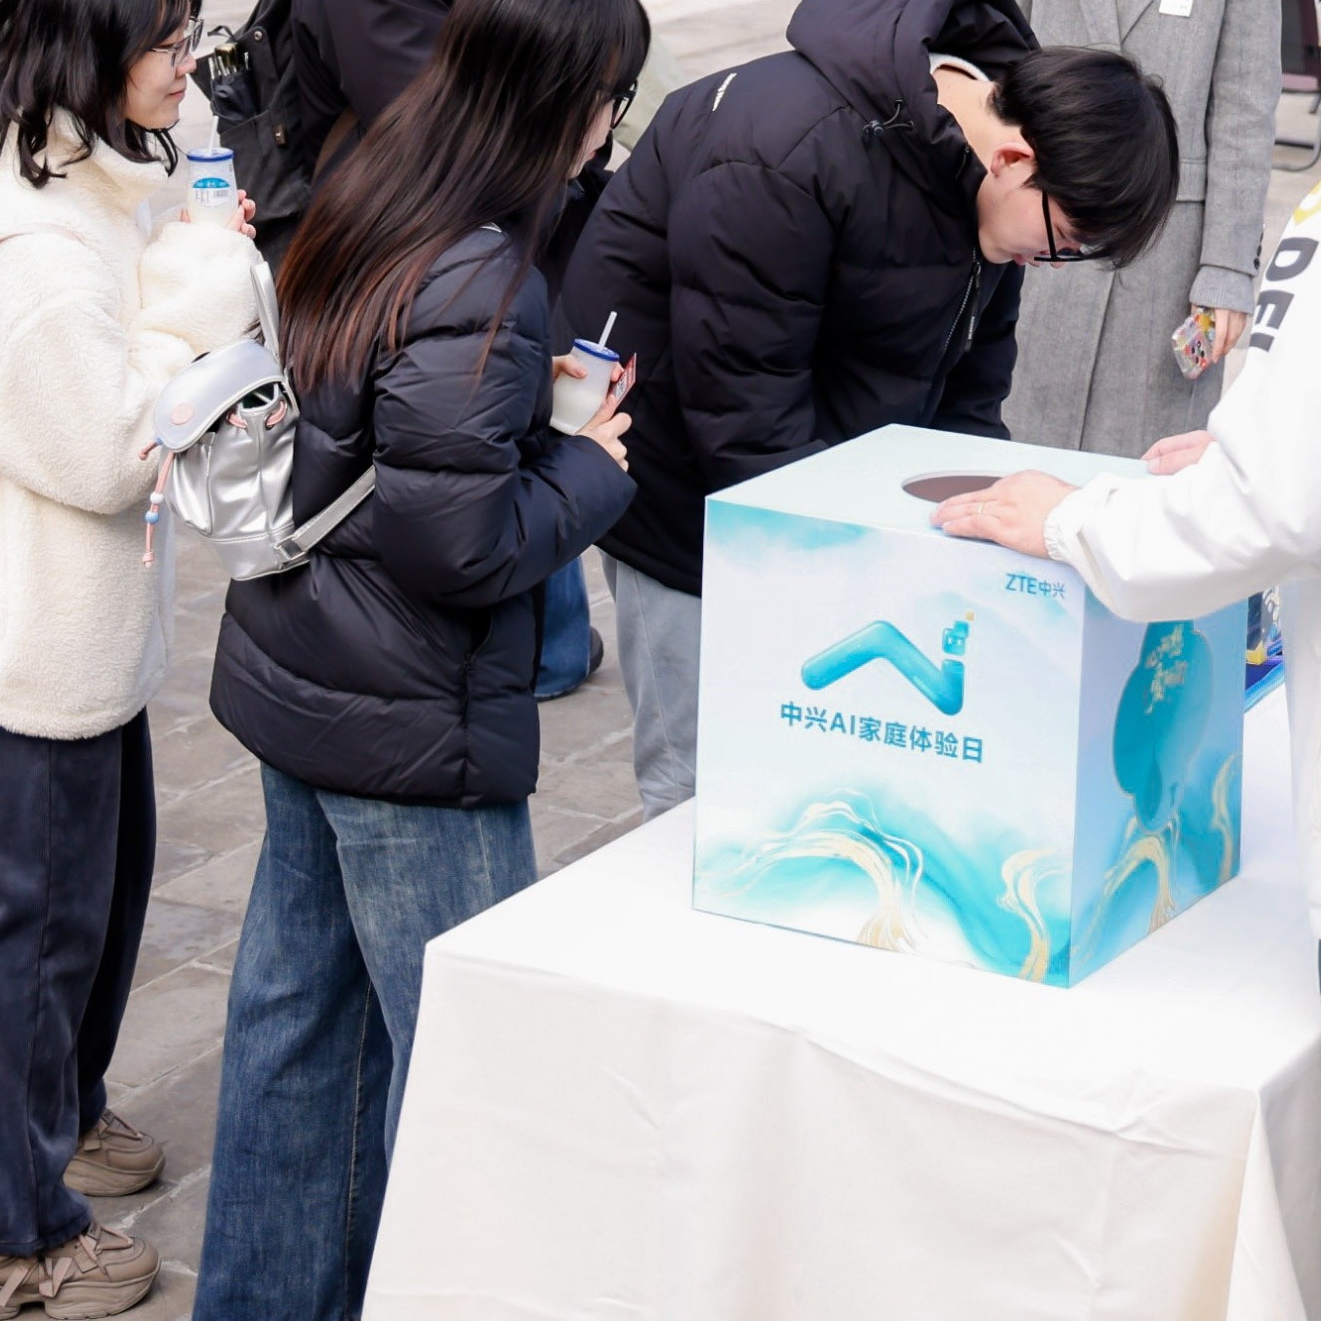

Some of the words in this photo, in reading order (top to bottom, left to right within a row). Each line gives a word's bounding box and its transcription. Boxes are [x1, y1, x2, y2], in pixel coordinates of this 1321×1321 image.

[1005, 572, 1066, 599] ZTE中兴
[780, 701, 984, 763] 中兴AI家庭体验日
